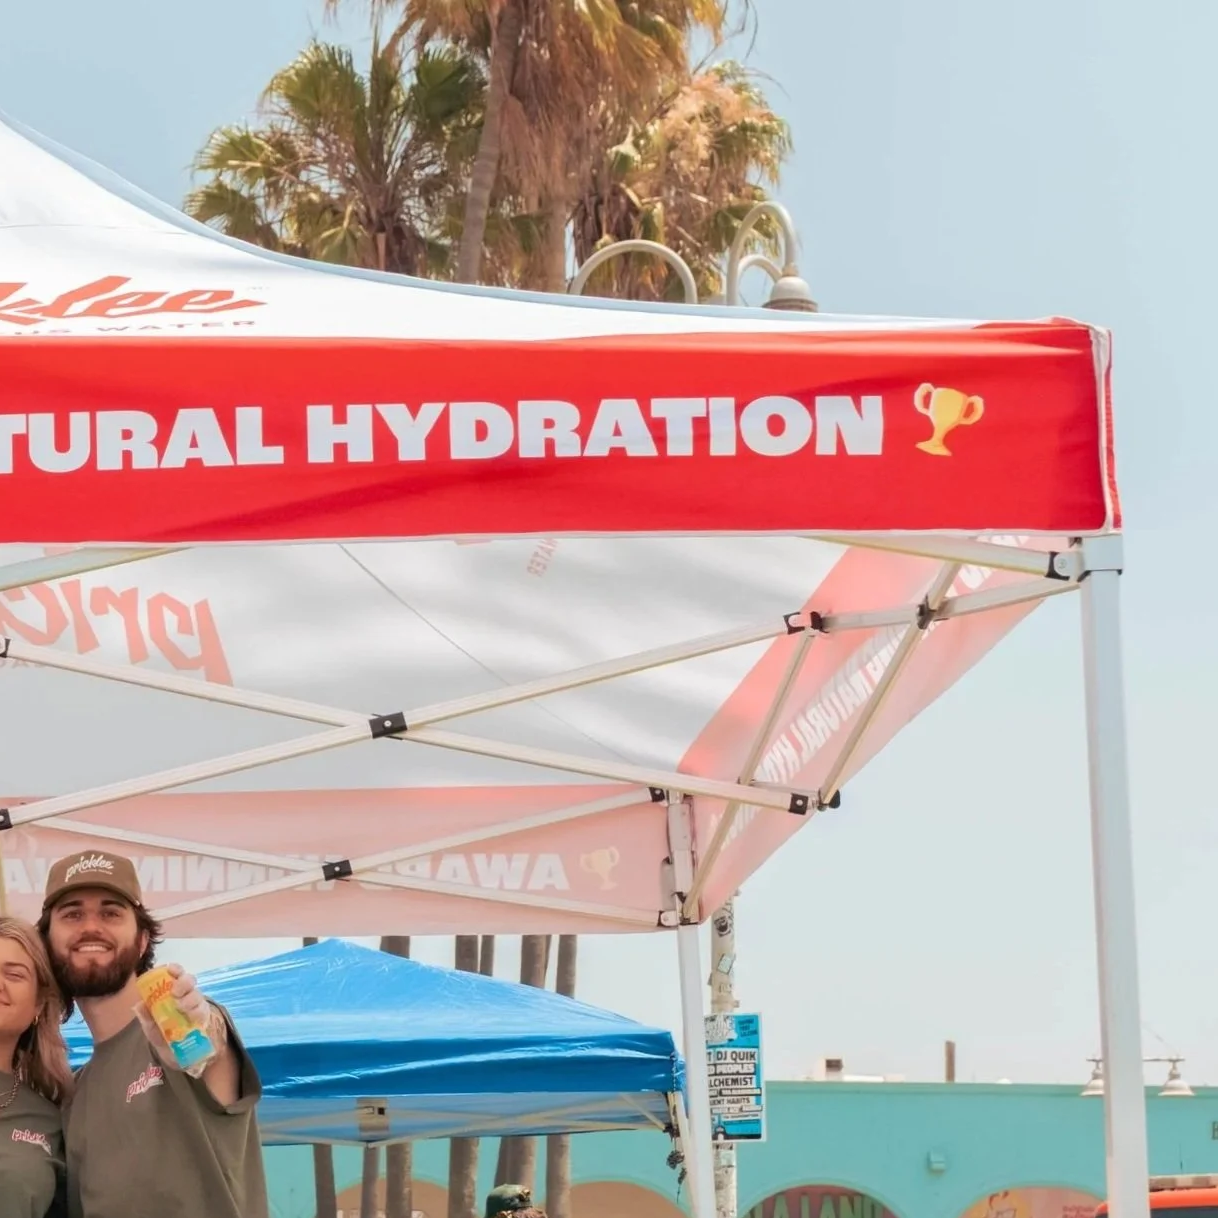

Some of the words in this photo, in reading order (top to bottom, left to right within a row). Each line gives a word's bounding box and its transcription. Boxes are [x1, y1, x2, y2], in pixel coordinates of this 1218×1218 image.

[306, 395, 884, 463] HYDRATION
[716, 1051, 727, 1061] DJ
[730, 1051, 757, 1063] QUIK
[709, 1076, 754, 1087] LCHEMIST
